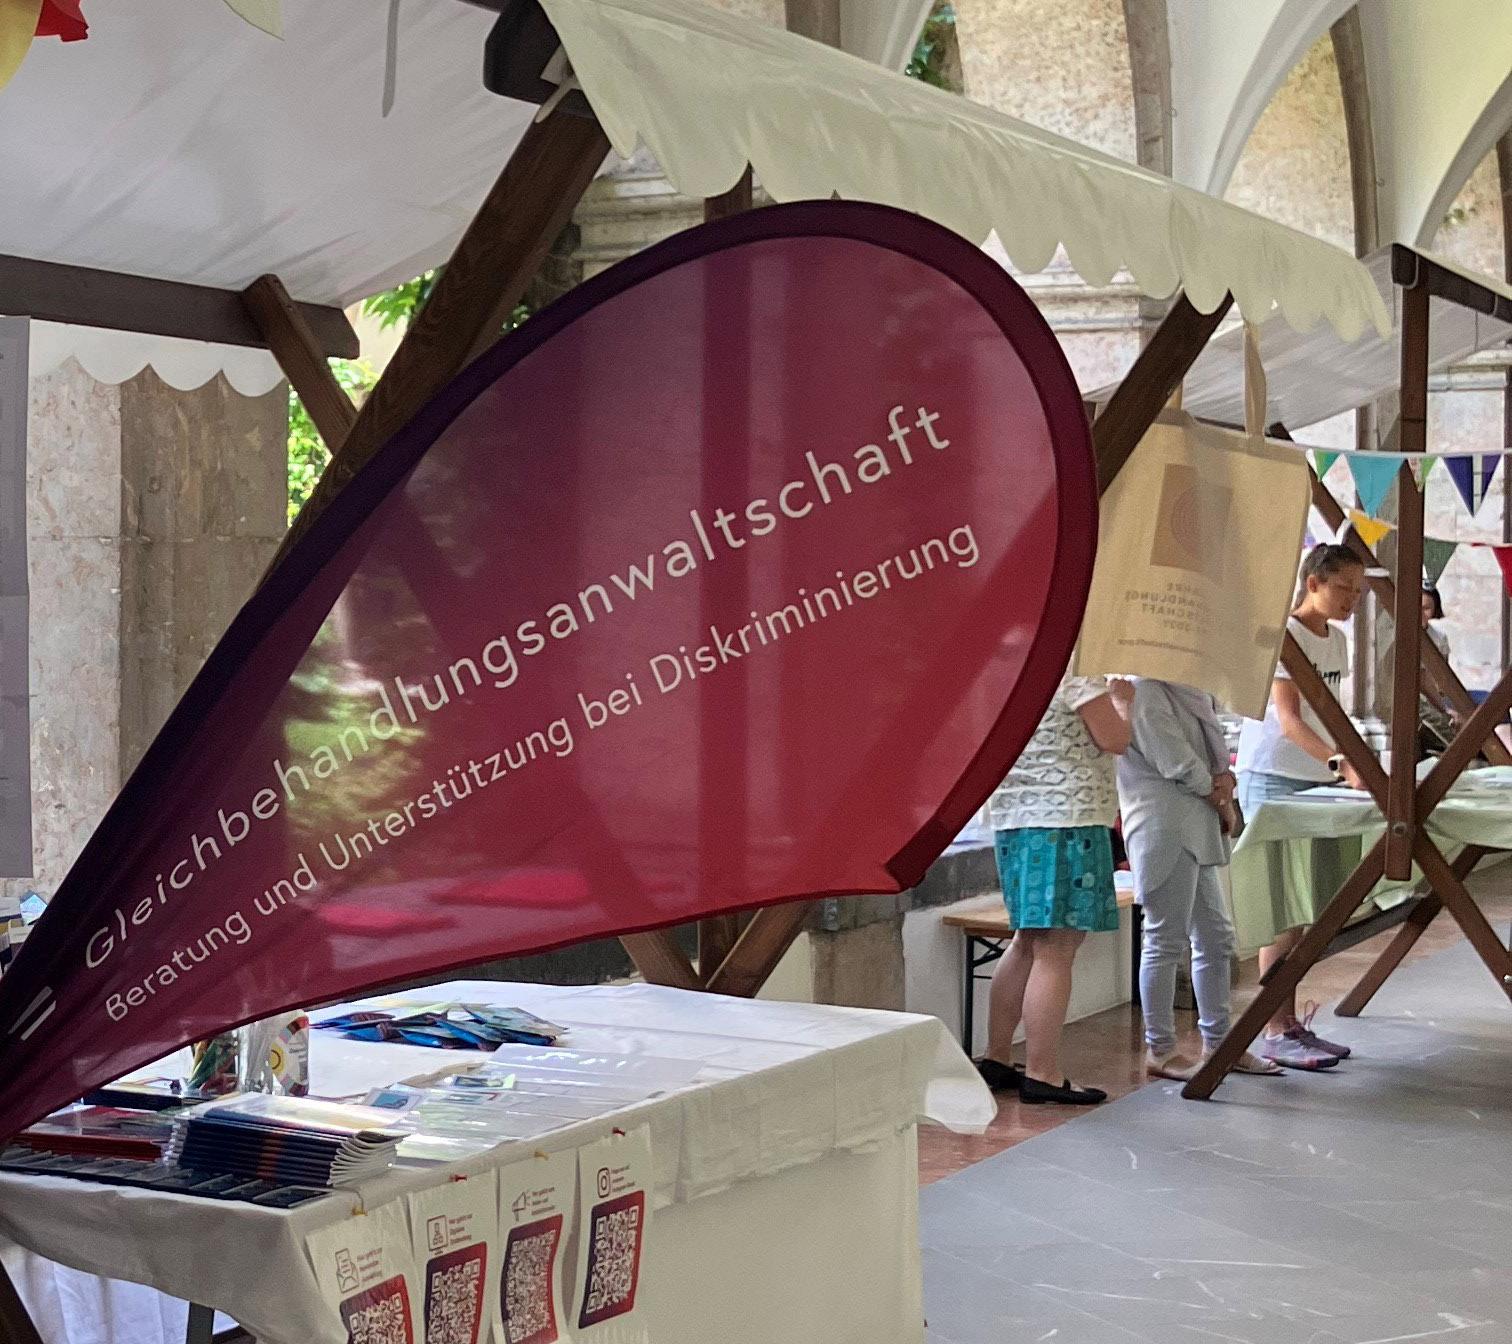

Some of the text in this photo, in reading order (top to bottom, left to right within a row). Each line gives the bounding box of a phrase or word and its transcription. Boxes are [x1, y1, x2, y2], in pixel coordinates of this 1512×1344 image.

[85, 406, 950, 969] Gleichbehandlungsanwaltschaft
[105, 524, 980, 1022] Beratung und Unterstützung bei Diskriminierung
